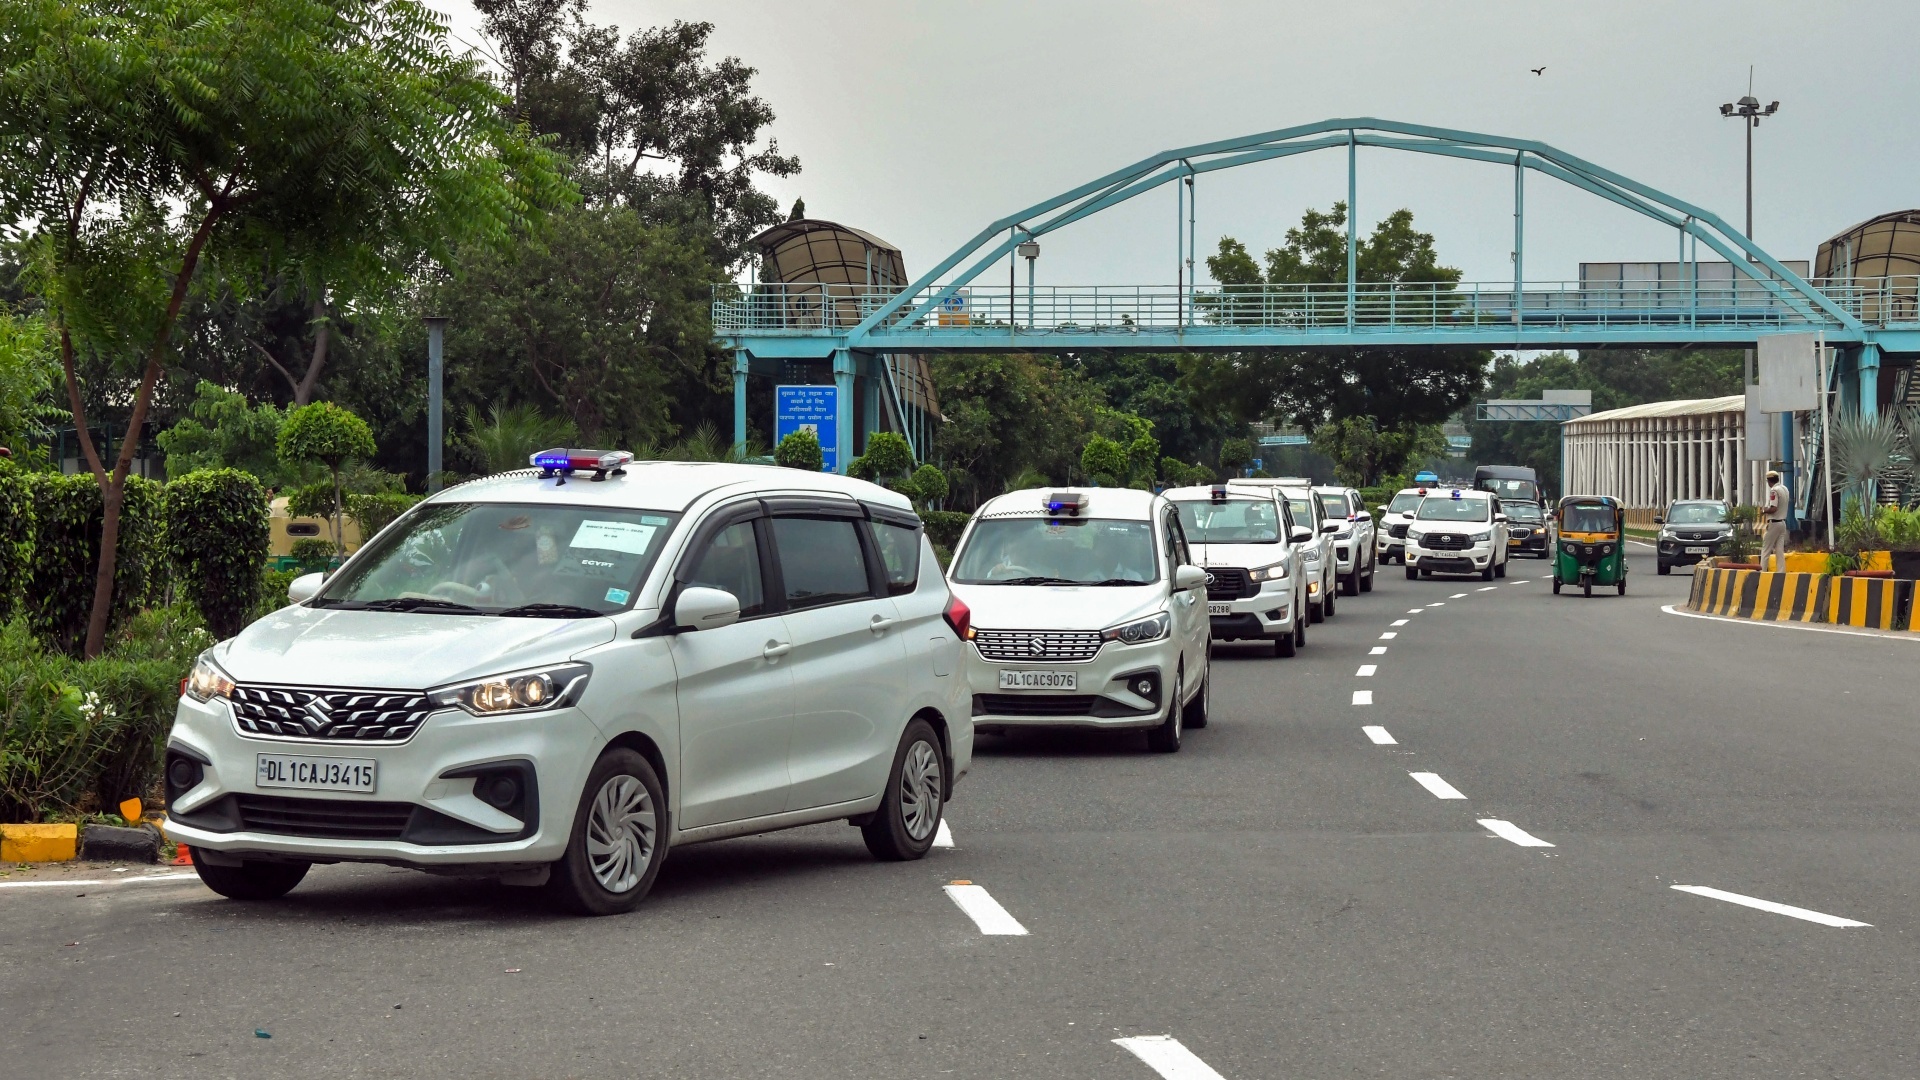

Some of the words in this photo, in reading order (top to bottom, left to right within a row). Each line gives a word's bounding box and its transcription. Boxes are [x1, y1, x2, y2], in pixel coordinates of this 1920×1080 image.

[581, 559, 615, 568] EGYPT
[1007, 673, 1074, 687] DL1CAC9076
[267, 760, 372, 786] DL1CAJ3415
